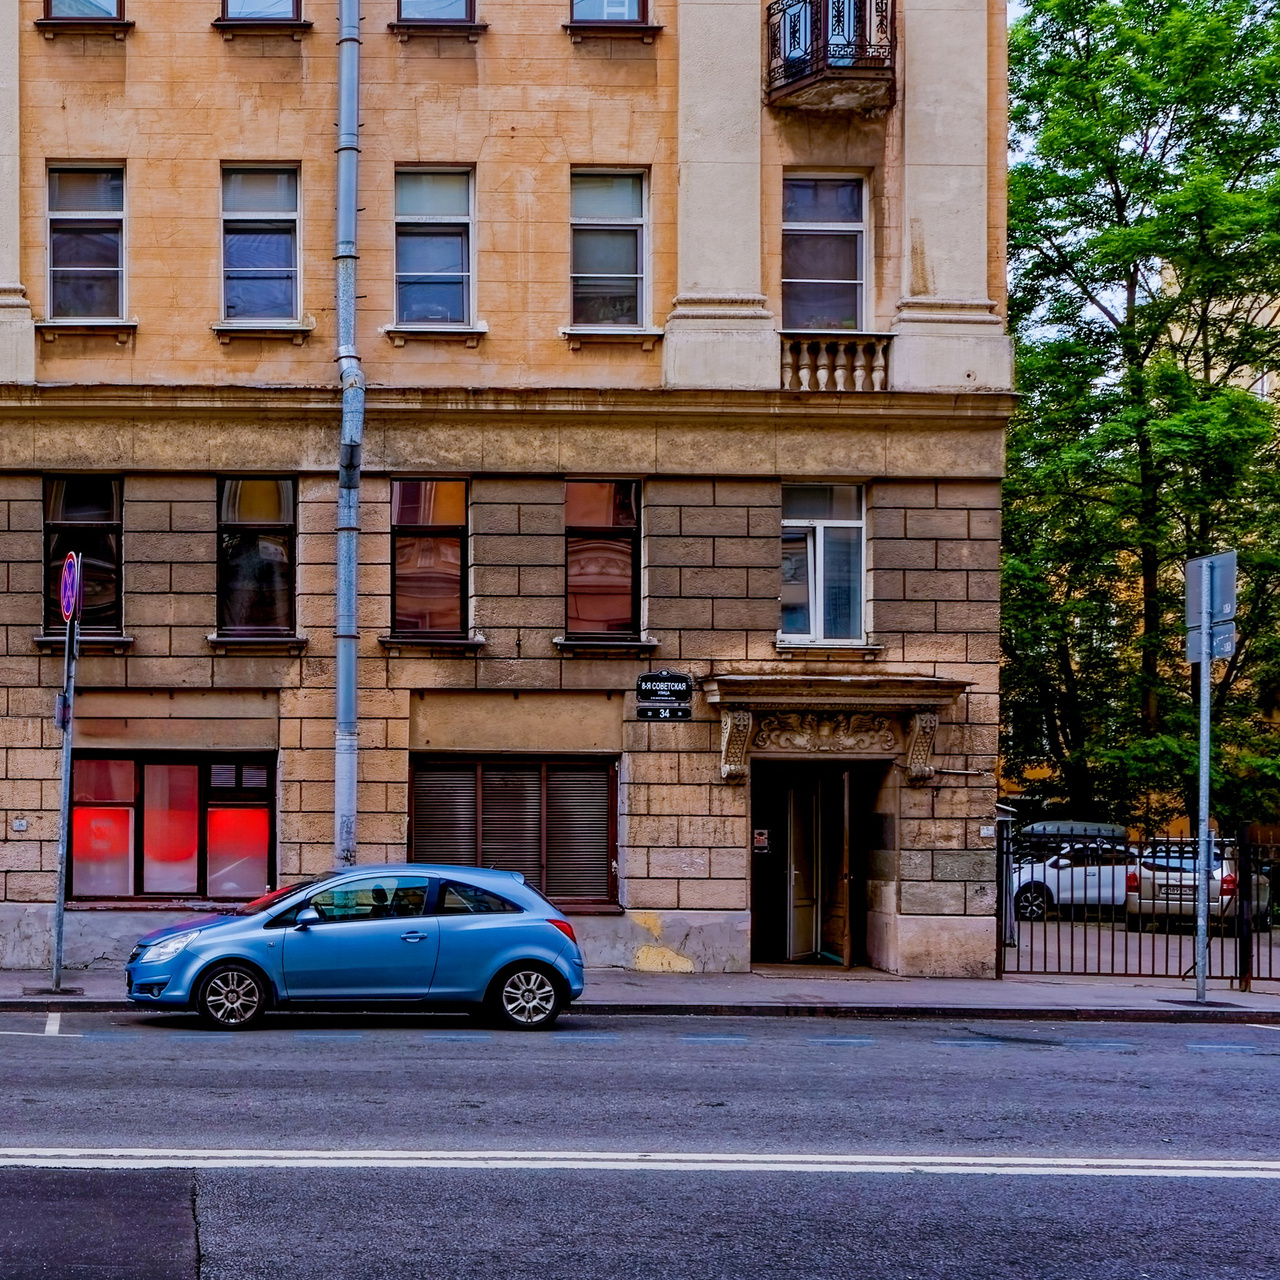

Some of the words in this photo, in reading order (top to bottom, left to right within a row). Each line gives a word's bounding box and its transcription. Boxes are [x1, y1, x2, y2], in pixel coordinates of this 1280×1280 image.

[641, 682, 651, 690] 8-Я
[652, 682, 686, 690] СОВЕТСКАЯ
[659, 709, 670, 718] 34
